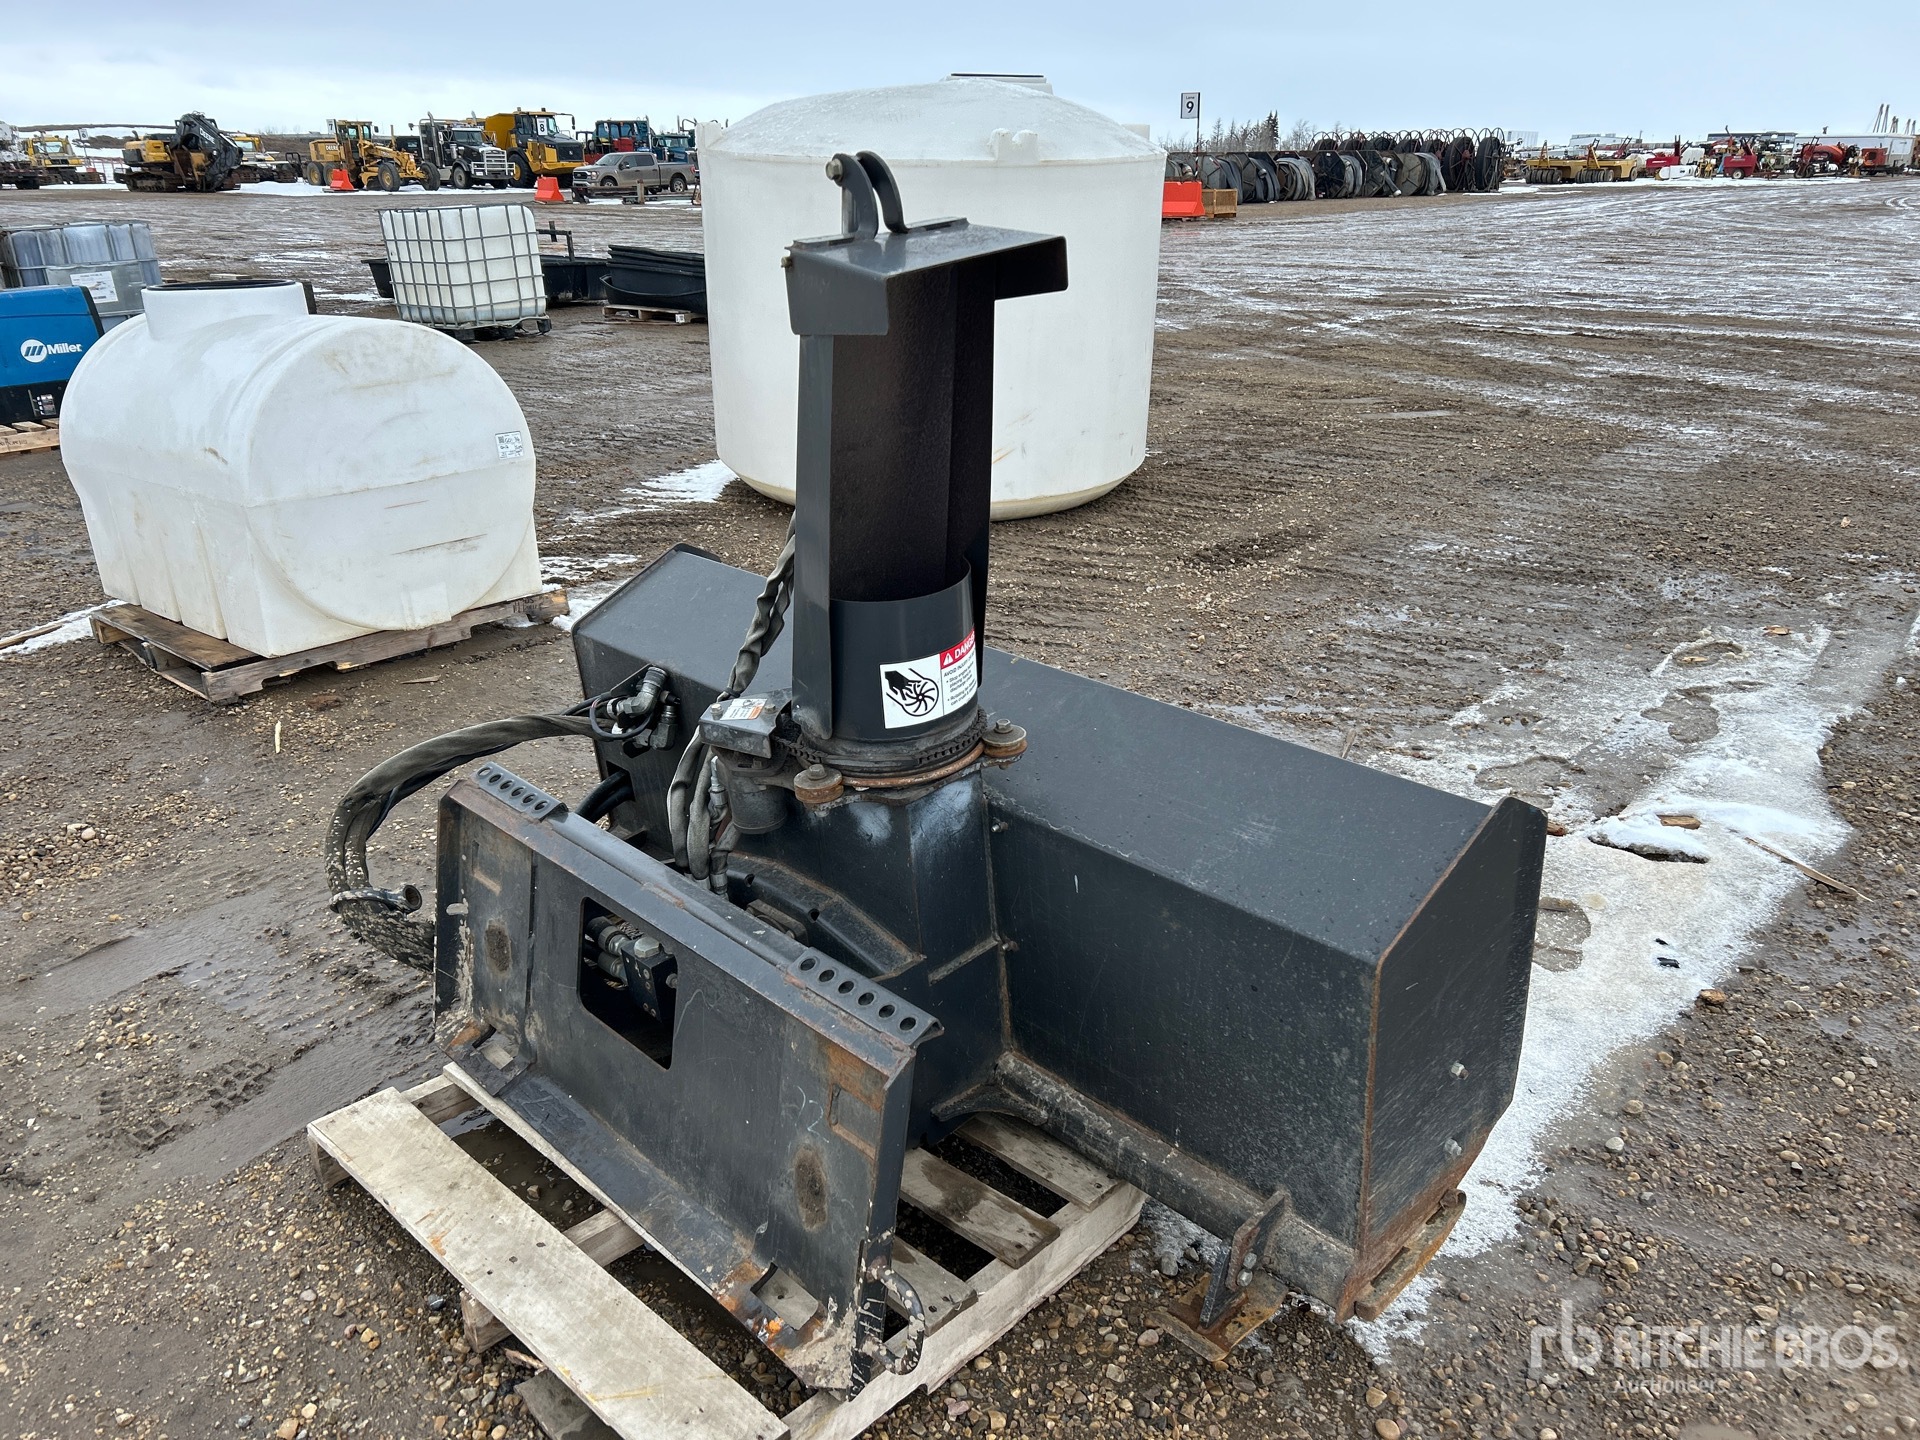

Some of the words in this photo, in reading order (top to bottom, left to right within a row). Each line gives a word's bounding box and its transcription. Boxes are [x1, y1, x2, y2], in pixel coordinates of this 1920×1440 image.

[1186, 101, 1194, 113] 9
[540, 123, 545, 132] 8
[47, 343, 82, 354] Miller
